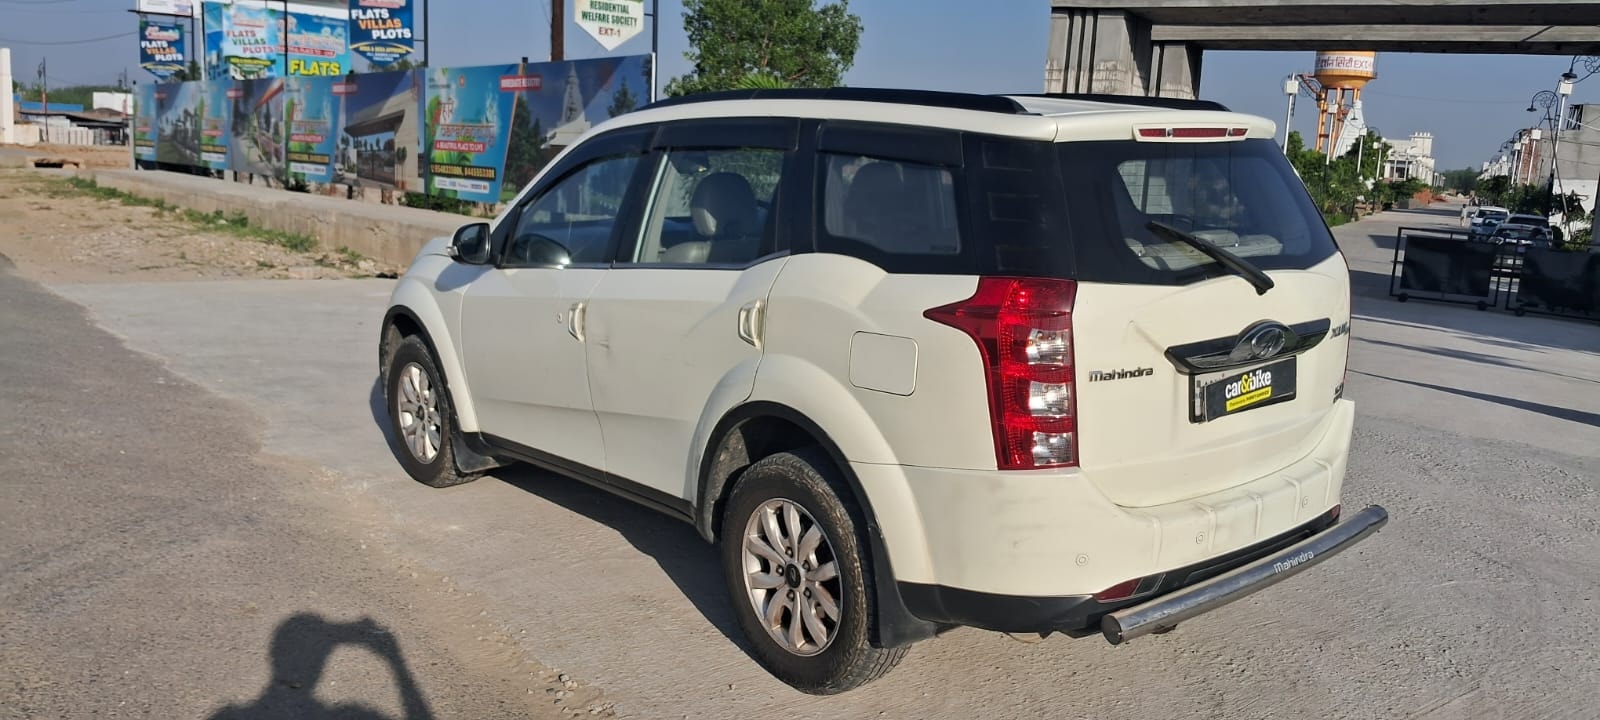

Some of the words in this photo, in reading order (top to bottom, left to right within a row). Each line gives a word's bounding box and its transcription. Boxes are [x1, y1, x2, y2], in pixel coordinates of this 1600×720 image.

[590, 1, 630, 14] RESIDENTIAL
[351, 8, 389, 20] FLATS
[581, 11, 610, 24] WELFARE
[611, 15, 637, 28] SOCIETY
[358, 17, 402, 30] VILLAS
[226, 30, 256, 38] FLATS
[371, 28, 412, 40] PLOTS
[598, 26, 621, 37] EXT-1
[141, 40, 168, 49] FLATS
[231, 38, 266, 46] VILLAS
[146, 47, 177, 55] VILLAS
[242, 46, 274, 54] PLOTS
[154, 53, 184, 62] PLOTS
[289, 59, 341, 77] FLATS
[1088, 366, 1154, 382] Mahindra
[1225, 369, 1272, 399] car&bike
[1273, 550, 1315, 574] Mahindra
